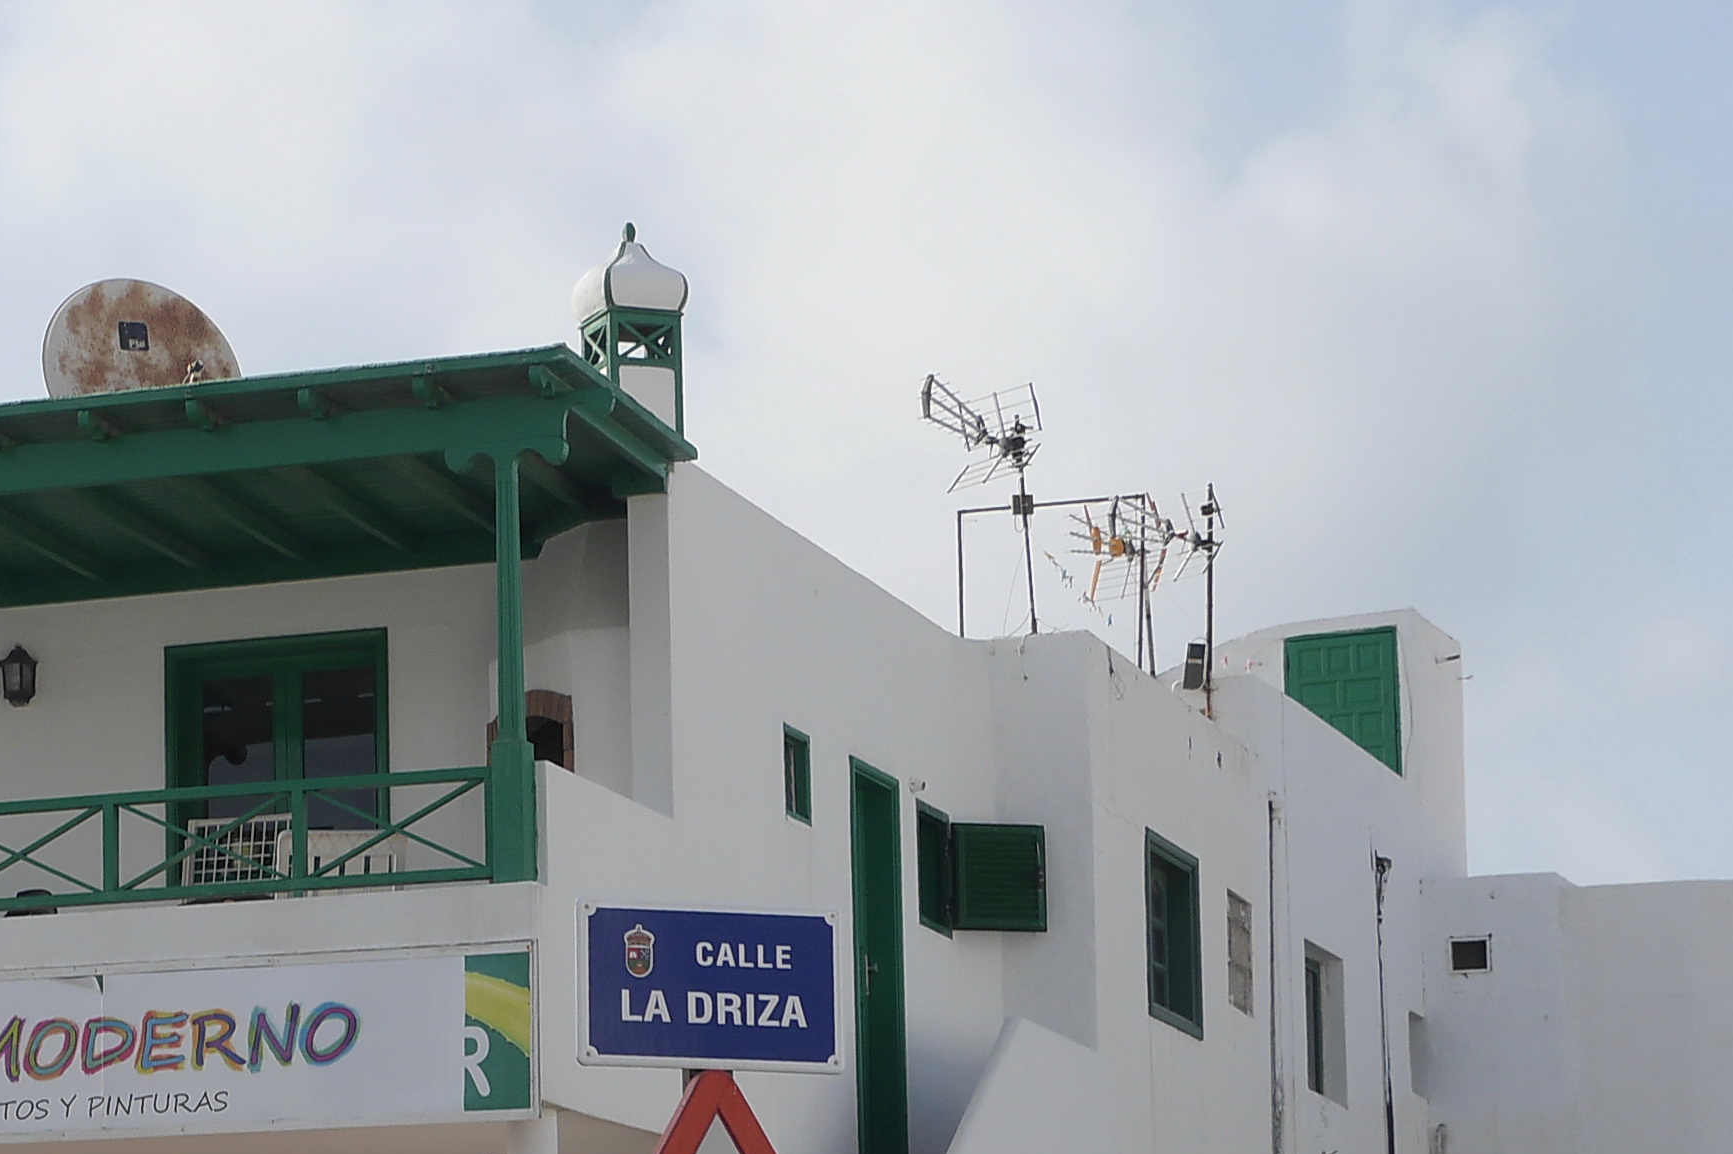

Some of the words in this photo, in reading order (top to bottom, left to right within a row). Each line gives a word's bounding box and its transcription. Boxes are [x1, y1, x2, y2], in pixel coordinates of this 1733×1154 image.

[695, 941, 792, 969] CALLE
[621, 988, 672, 1024] LA
[687, 990, 808, 1029] DRIZA
[60, 1095, 77, 1118] Y
[88, 1091, 229, 1118] PINTURAS
